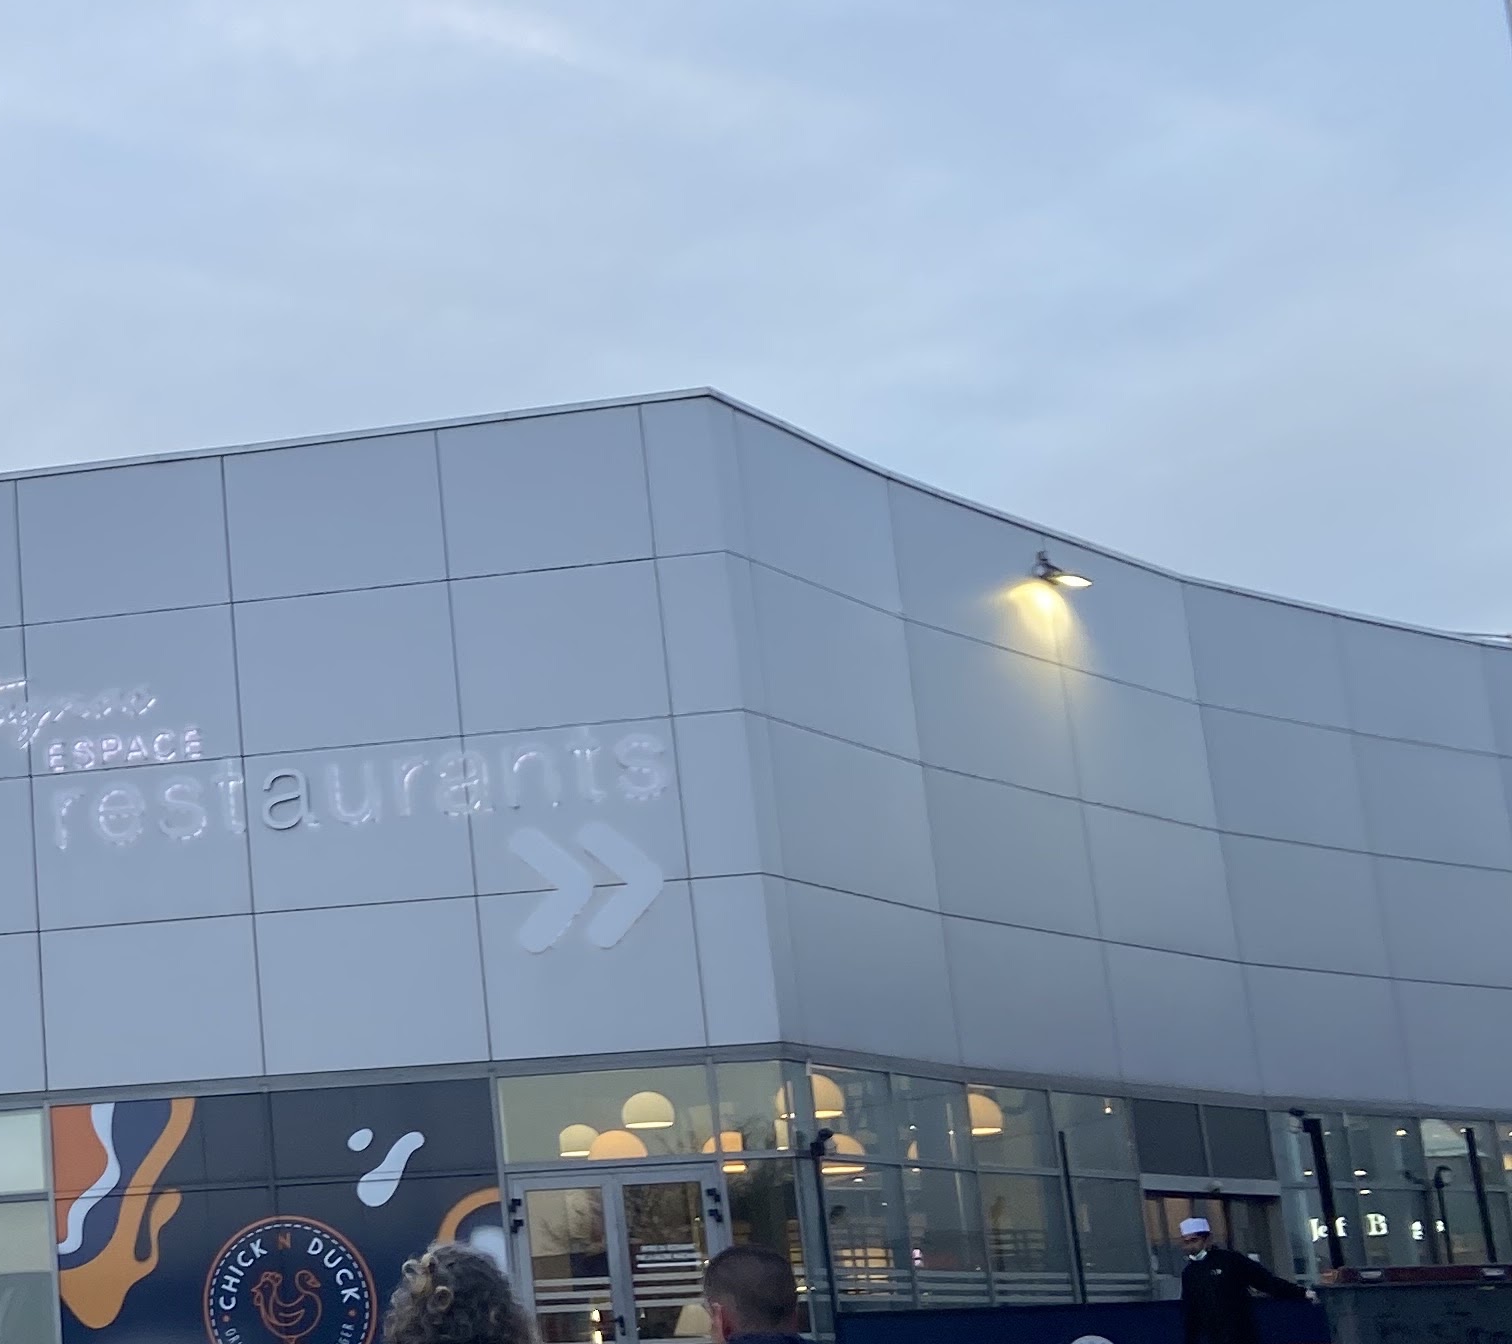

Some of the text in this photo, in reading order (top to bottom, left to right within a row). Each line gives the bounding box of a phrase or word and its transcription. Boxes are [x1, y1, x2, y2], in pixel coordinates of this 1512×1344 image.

[46, 726, 204, 771] ESPACE
[52, 727, 669, 850] restaurants
[219, 1232, 361, 1310] CHICK N DUCK
